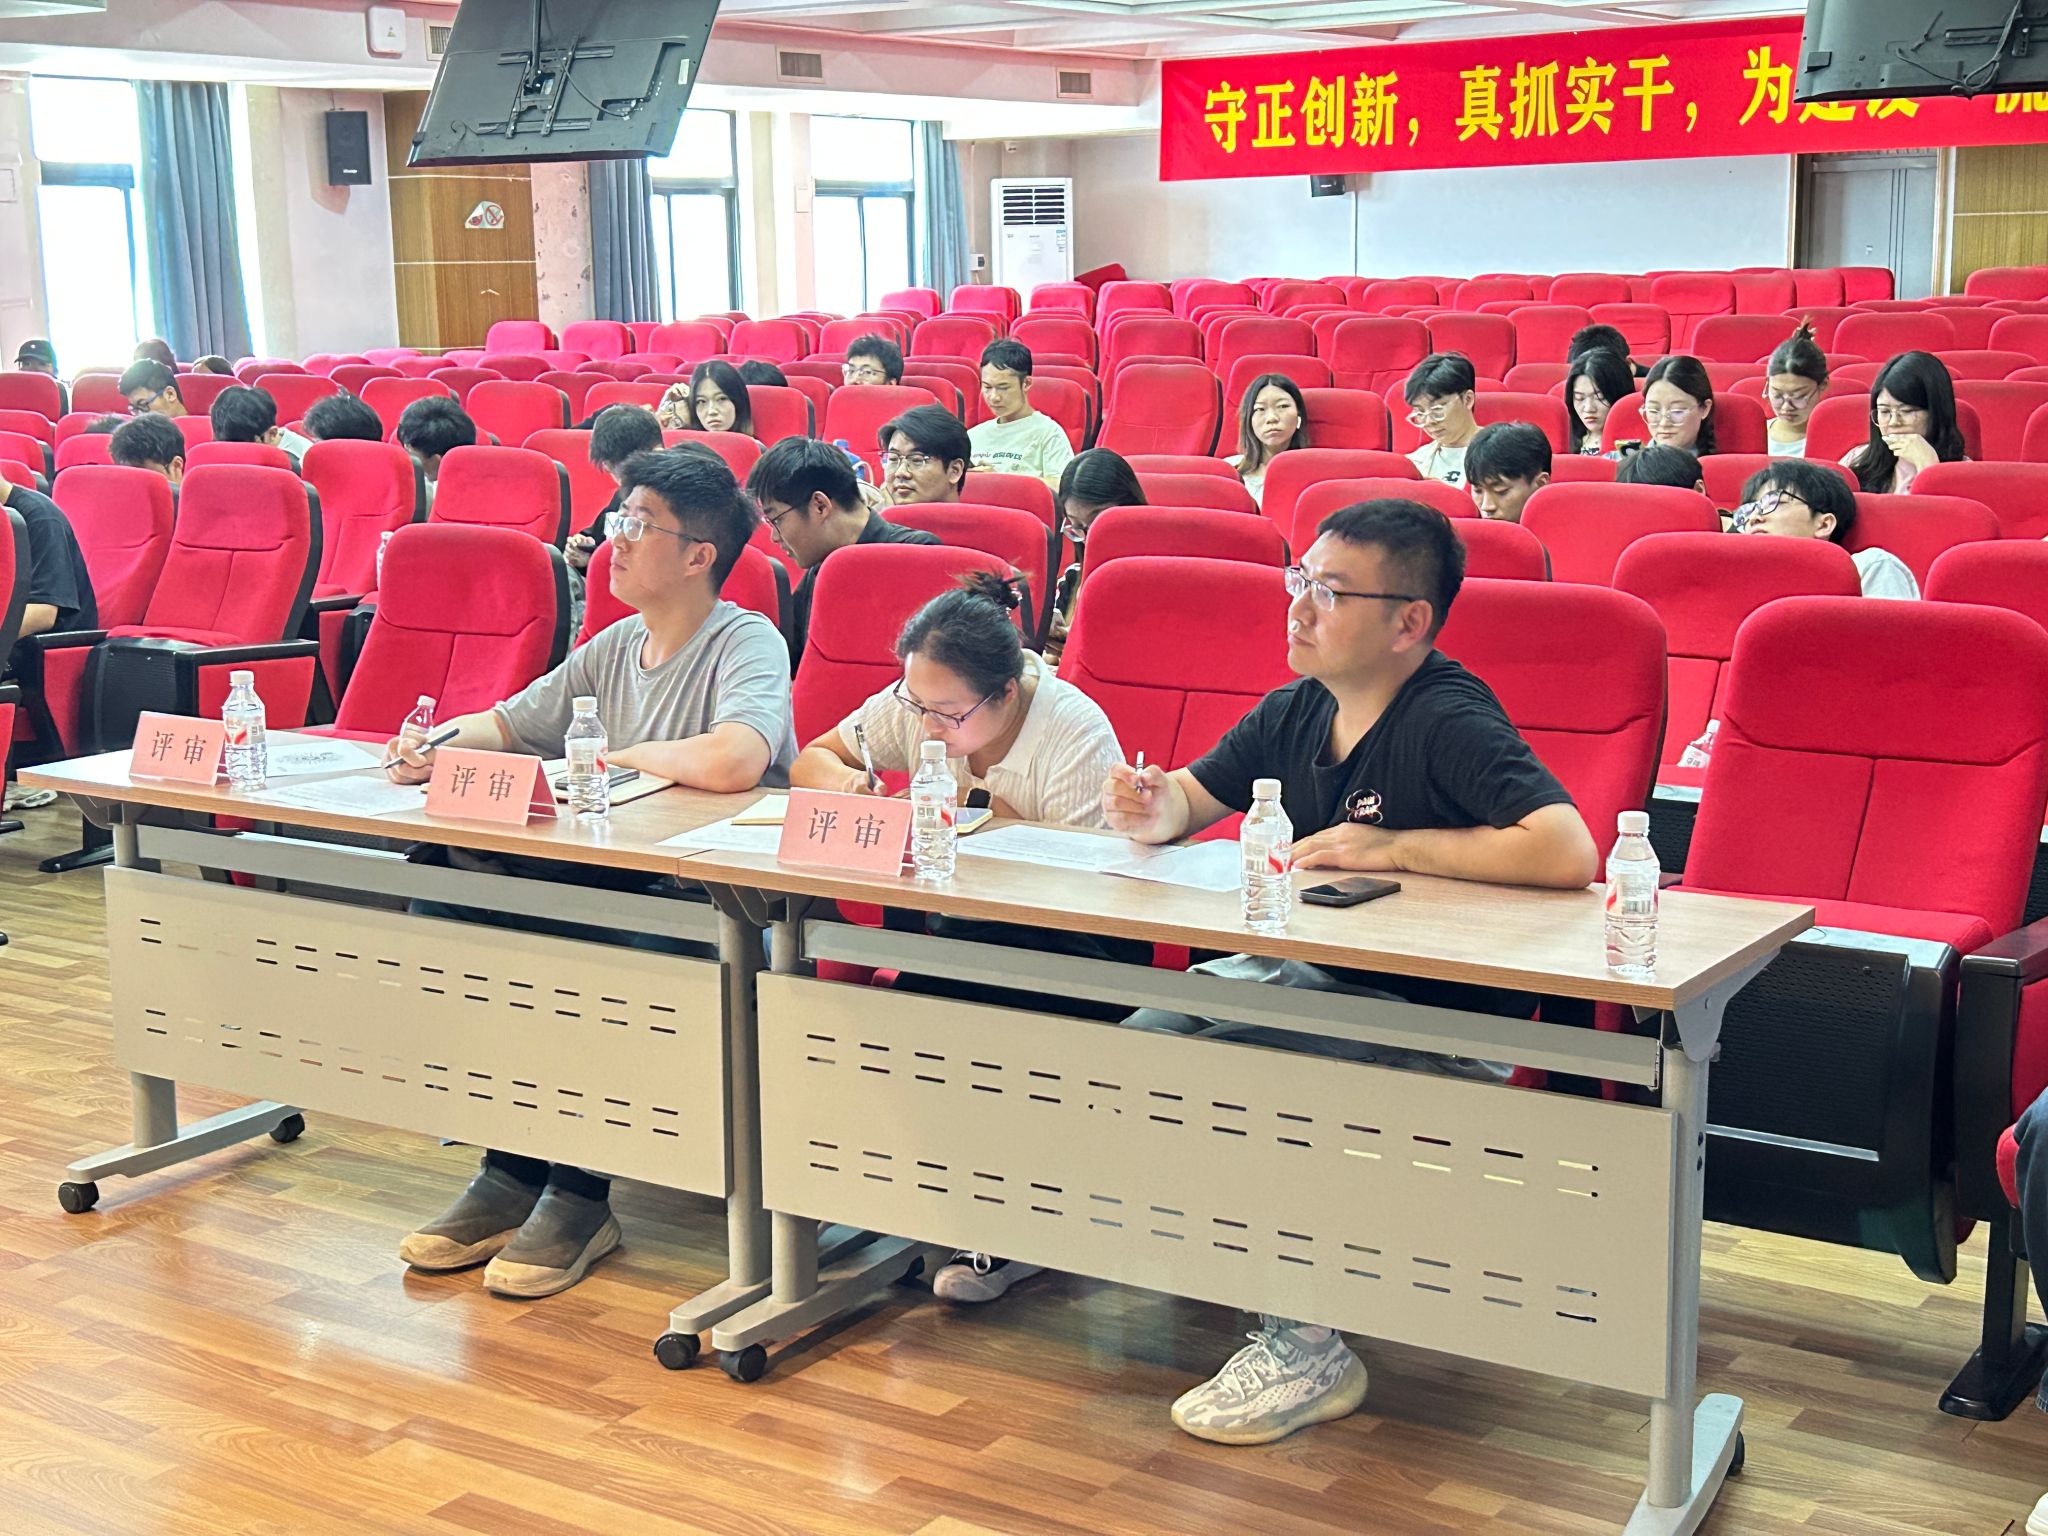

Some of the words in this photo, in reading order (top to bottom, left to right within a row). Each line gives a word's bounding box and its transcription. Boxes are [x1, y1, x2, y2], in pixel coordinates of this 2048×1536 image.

[152, 730, 207, 765] 评审
[451, 764, 515, 801] 评审
[808, 807, 886, 849] 评审
